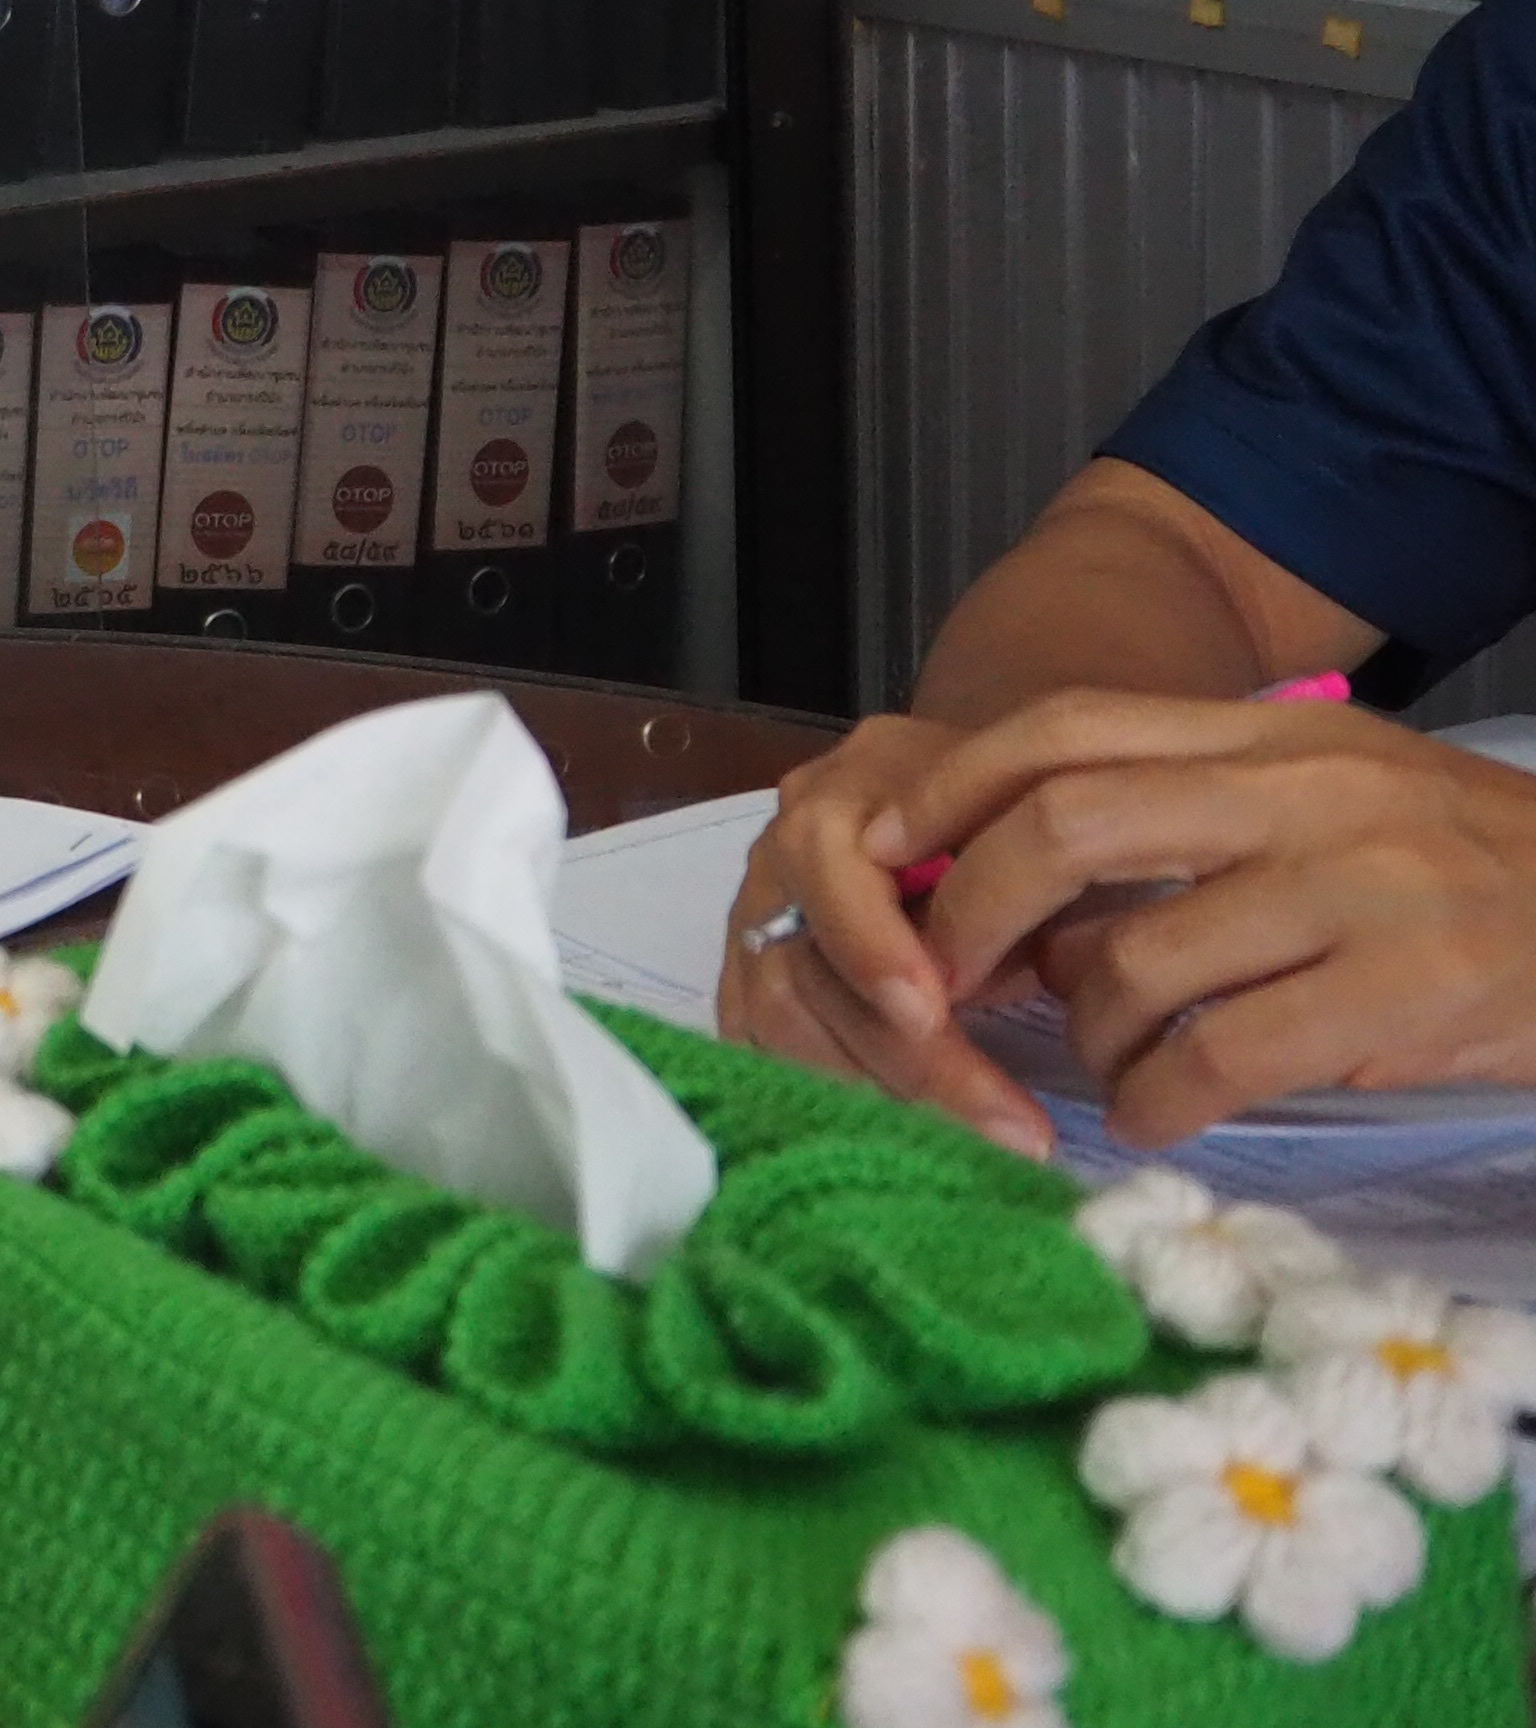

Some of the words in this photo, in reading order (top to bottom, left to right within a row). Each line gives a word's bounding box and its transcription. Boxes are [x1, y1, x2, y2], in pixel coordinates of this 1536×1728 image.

[73, 437, 130, 460] OTOP
[474, 459, 527, 477] OTOP
[336, 485, 393, 504] OTOP
[194, 509, 253, 529] OTOP
